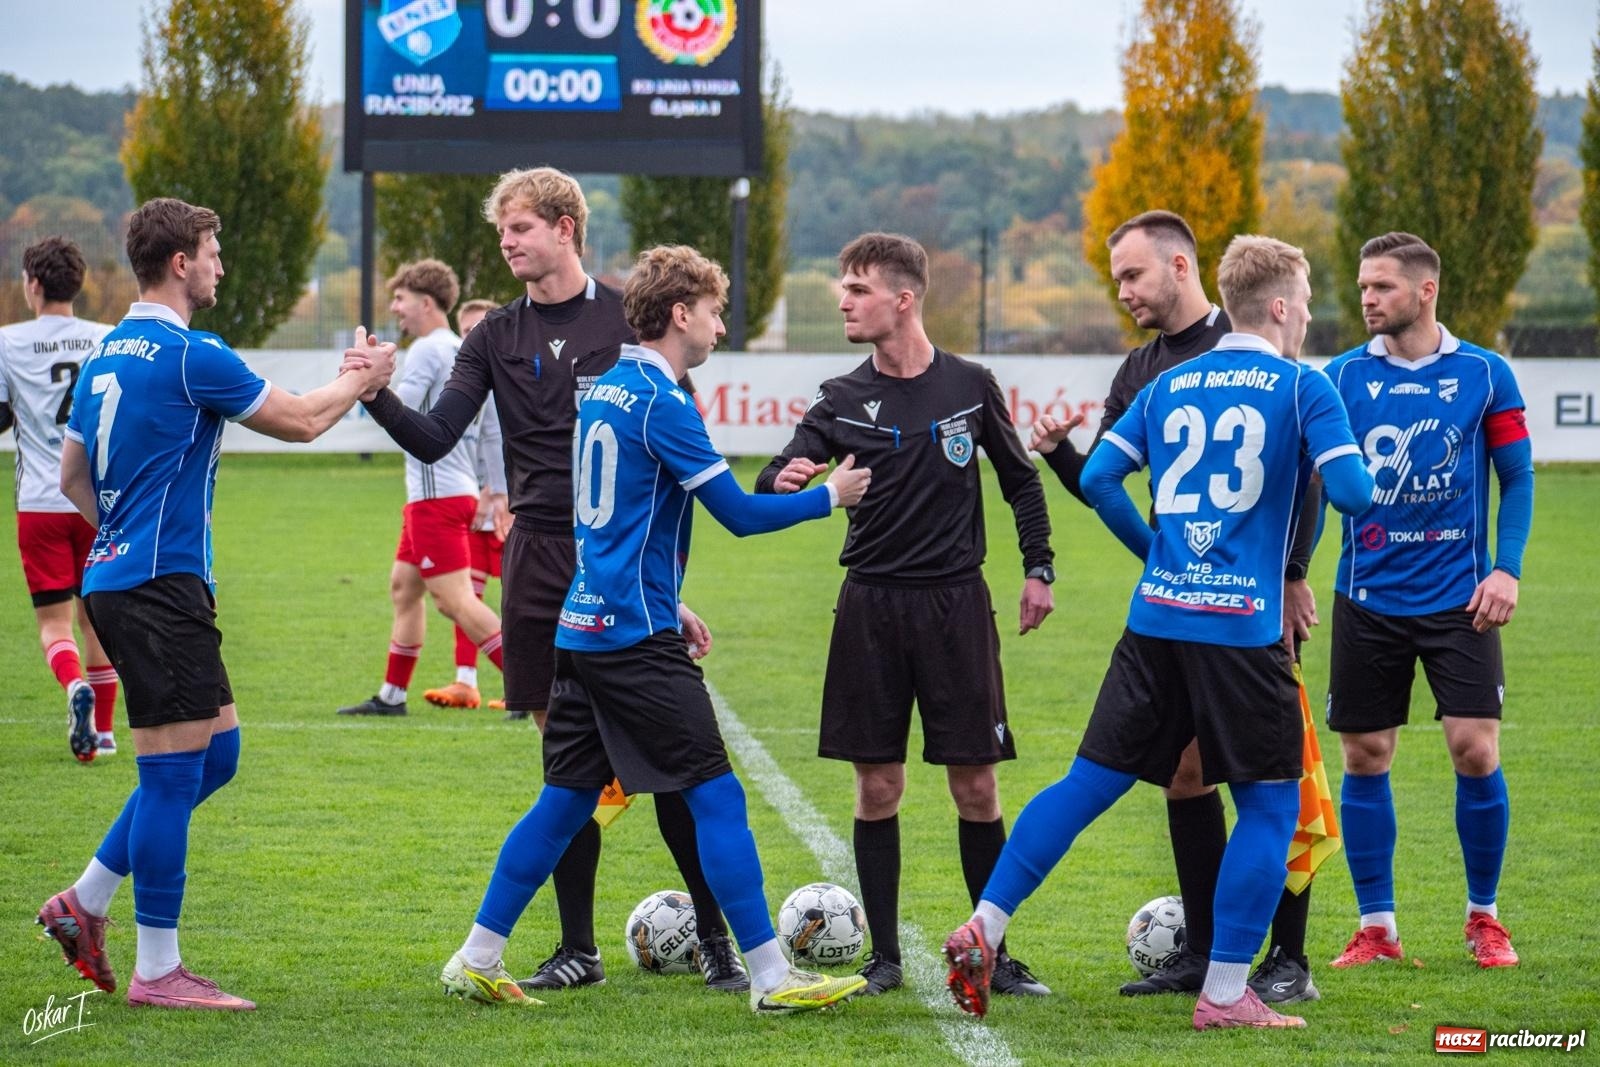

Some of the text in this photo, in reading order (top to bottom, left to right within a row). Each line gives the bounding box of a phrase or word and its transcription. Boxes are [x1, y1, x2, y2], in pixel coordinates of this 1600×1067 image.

[392, 74, 446, 95] UNIA
[504, 68, 602, 103] 00:00
[33, 338, 94, 355] UNIA TURZA
[104, 335, 161, 362] RACIBÓRZ
[1170, 366, 1281, 394] UNIA RACIBÓRZ
[1388, 382, 1431, 395] AGROTEAM
[91, 372, 122, 481] 7
[1155, 404, 1267, 515] 23
[1413, 472, 1453, 492] LAT
[1388, 531, 1425, 543] TOKAI
[1186, 561, 1213, 574] MB
[660, 914, 697, 957] SELECT
